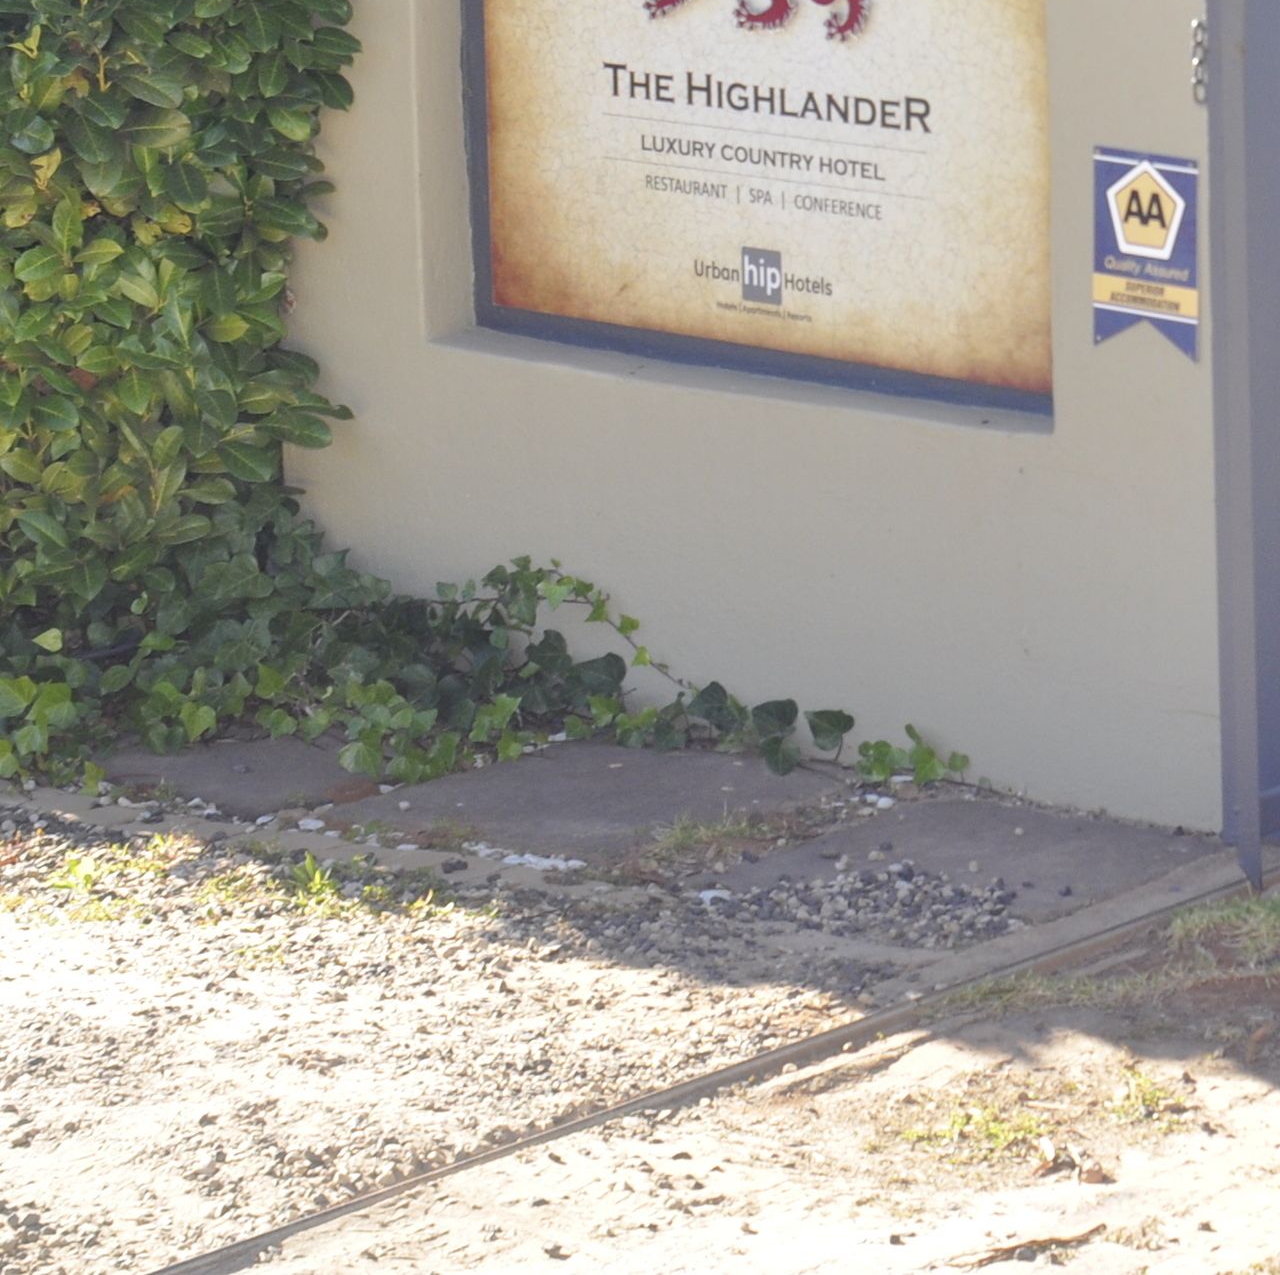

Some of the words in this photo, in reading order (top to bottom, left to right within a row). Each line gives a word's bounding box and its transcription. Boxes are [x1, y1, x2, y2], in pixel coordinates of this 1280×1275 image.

[603, 62, 674, 103] THE
[686, 71, 932, 133] HIGHLANDER
[641, 134, 716, 158] LUXURY
[720, 144, 815, 171] COUNTRY
[819, 157, 886, 181] HOTEL
[645, 174, 728, 199] RESTAURANT
[749, 188, 773, 206] SPA
[794, 194, 883, 220] CONFERENCE
[1124, 189, 1167, 228] AA
[694, 259, 740, 282] Urban
[743, 254, 781, 296] hip
[784, 273, 833, 296] Hotels
[1104, 256, 1140, 275] Quality
[1144, 263, 1190, 281] Assured
